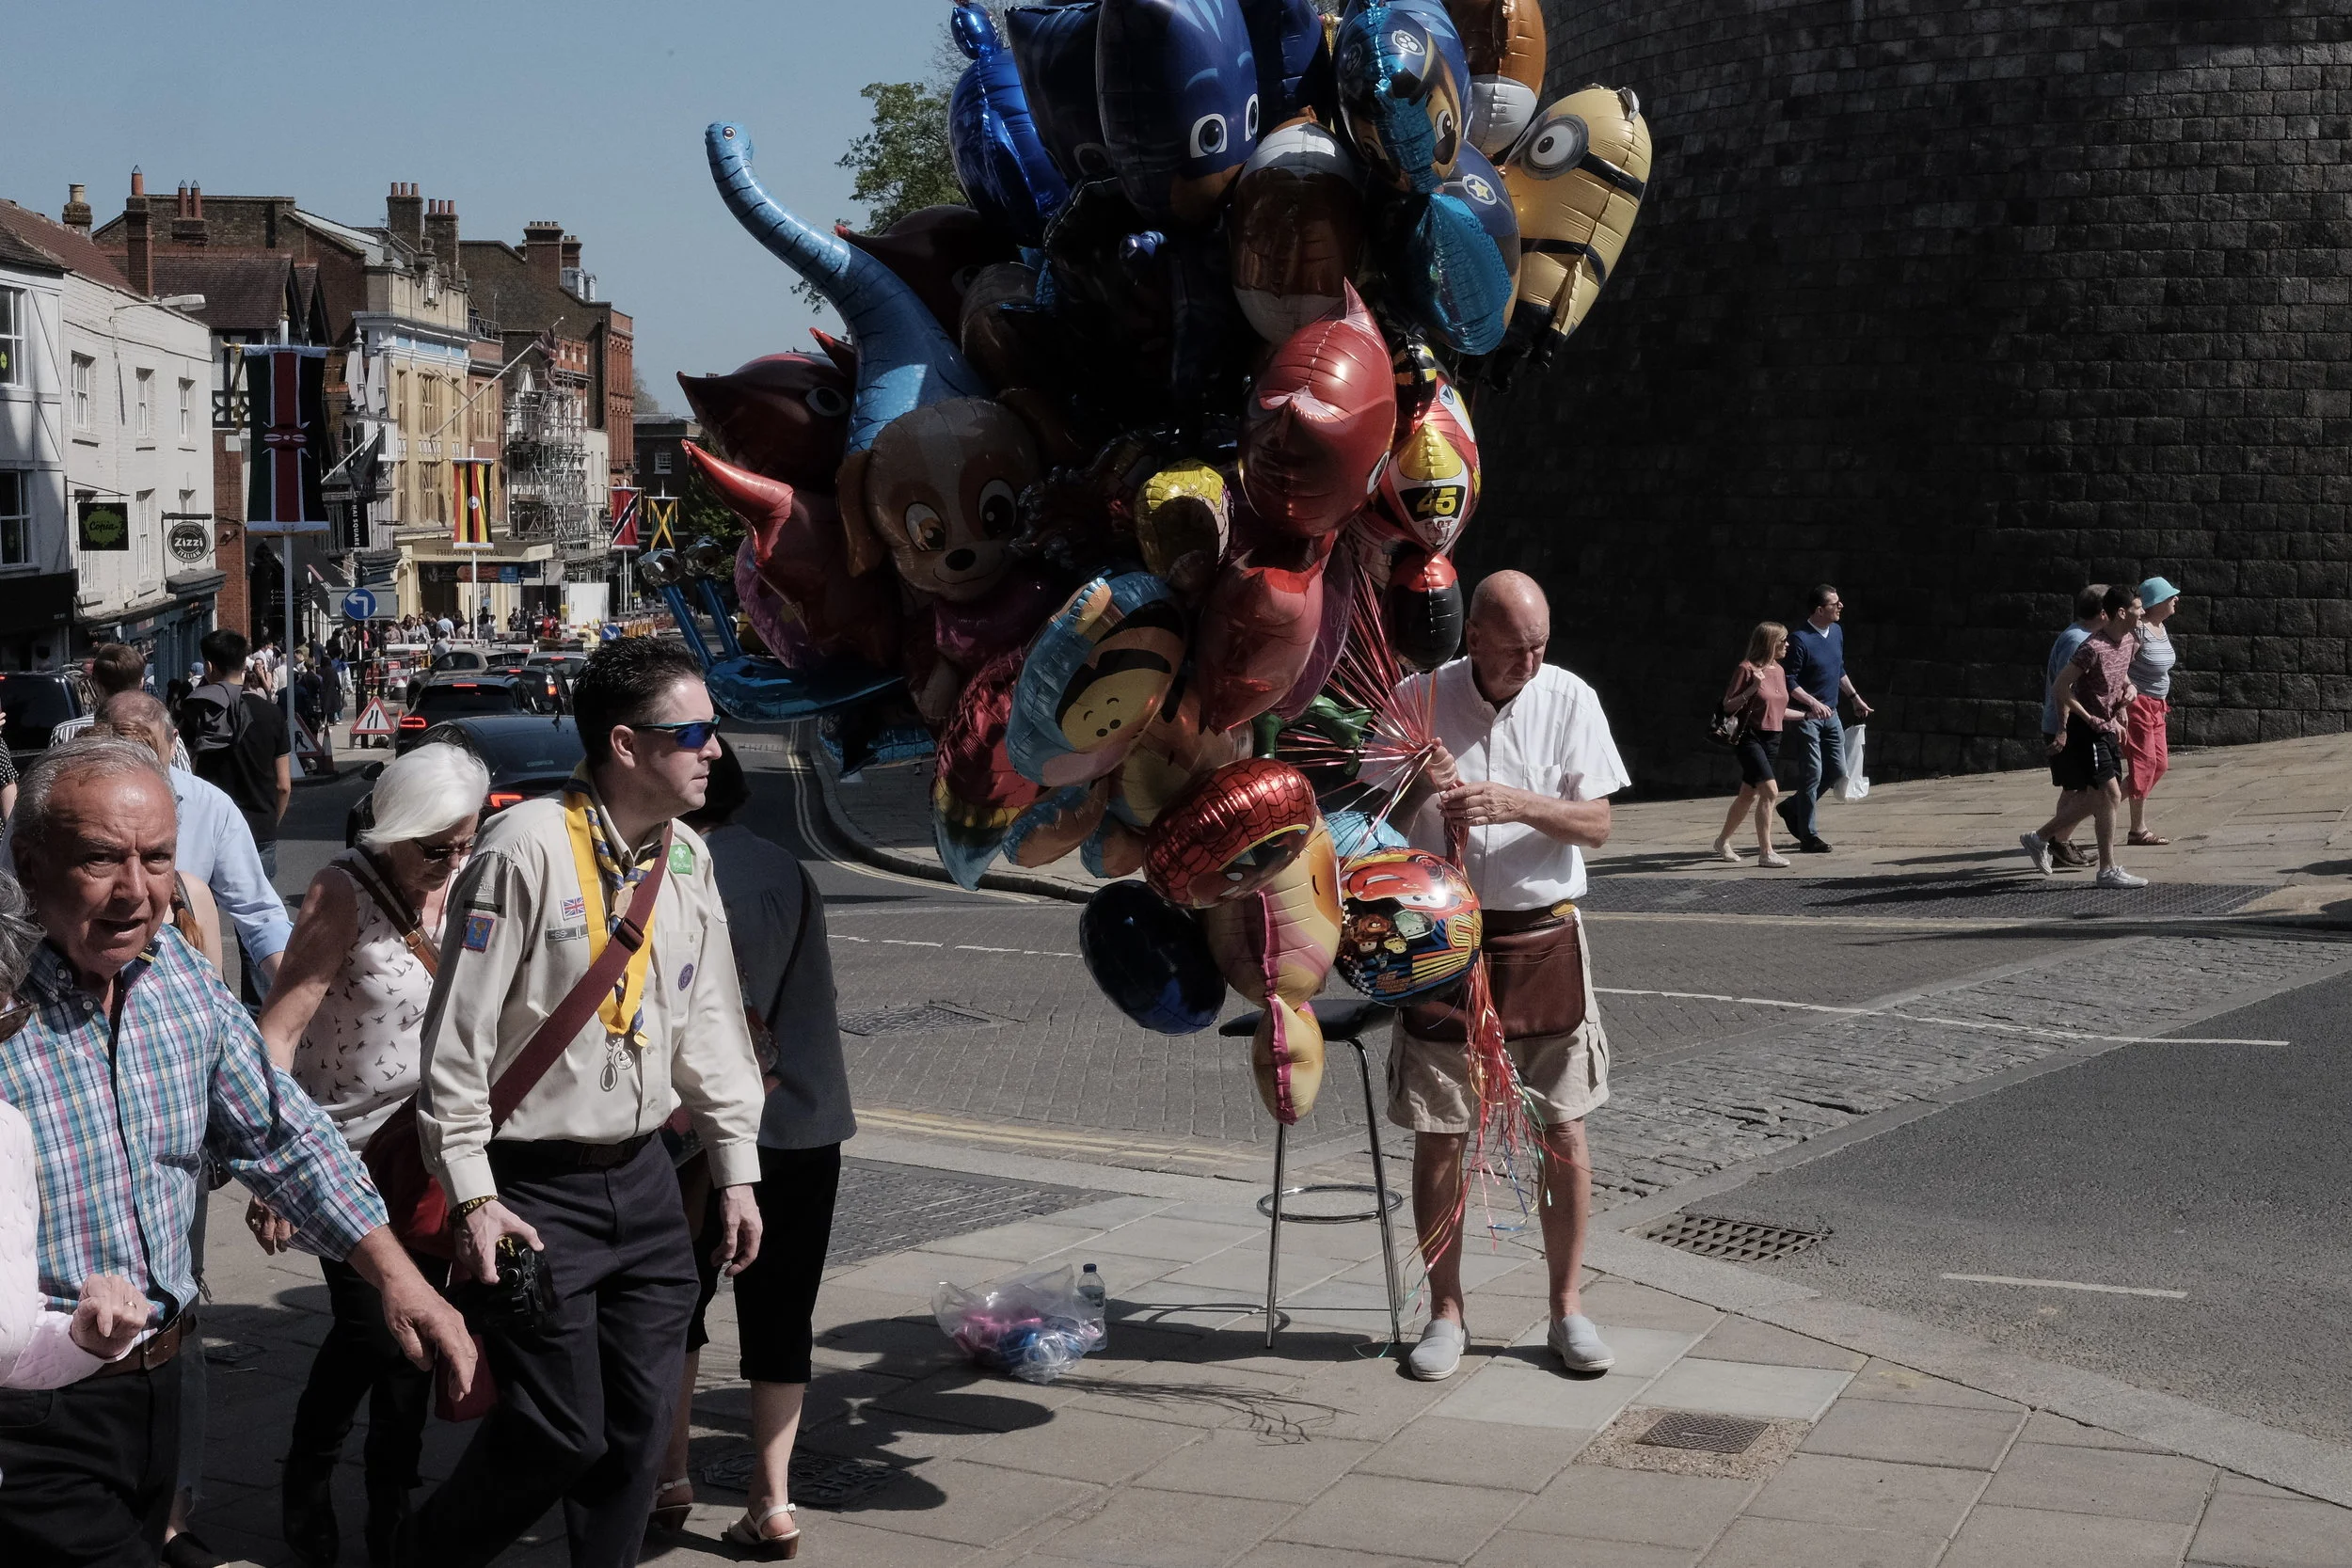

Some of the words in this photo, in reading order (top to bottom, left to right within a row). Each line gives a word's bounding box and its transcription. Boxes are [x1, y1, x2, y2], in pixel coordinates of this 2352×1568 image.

[1416, 486, 1458, 515] 45
[177, 550, 201, 559] ITALIAN
[436, 548, 472, 557] THEATRE
